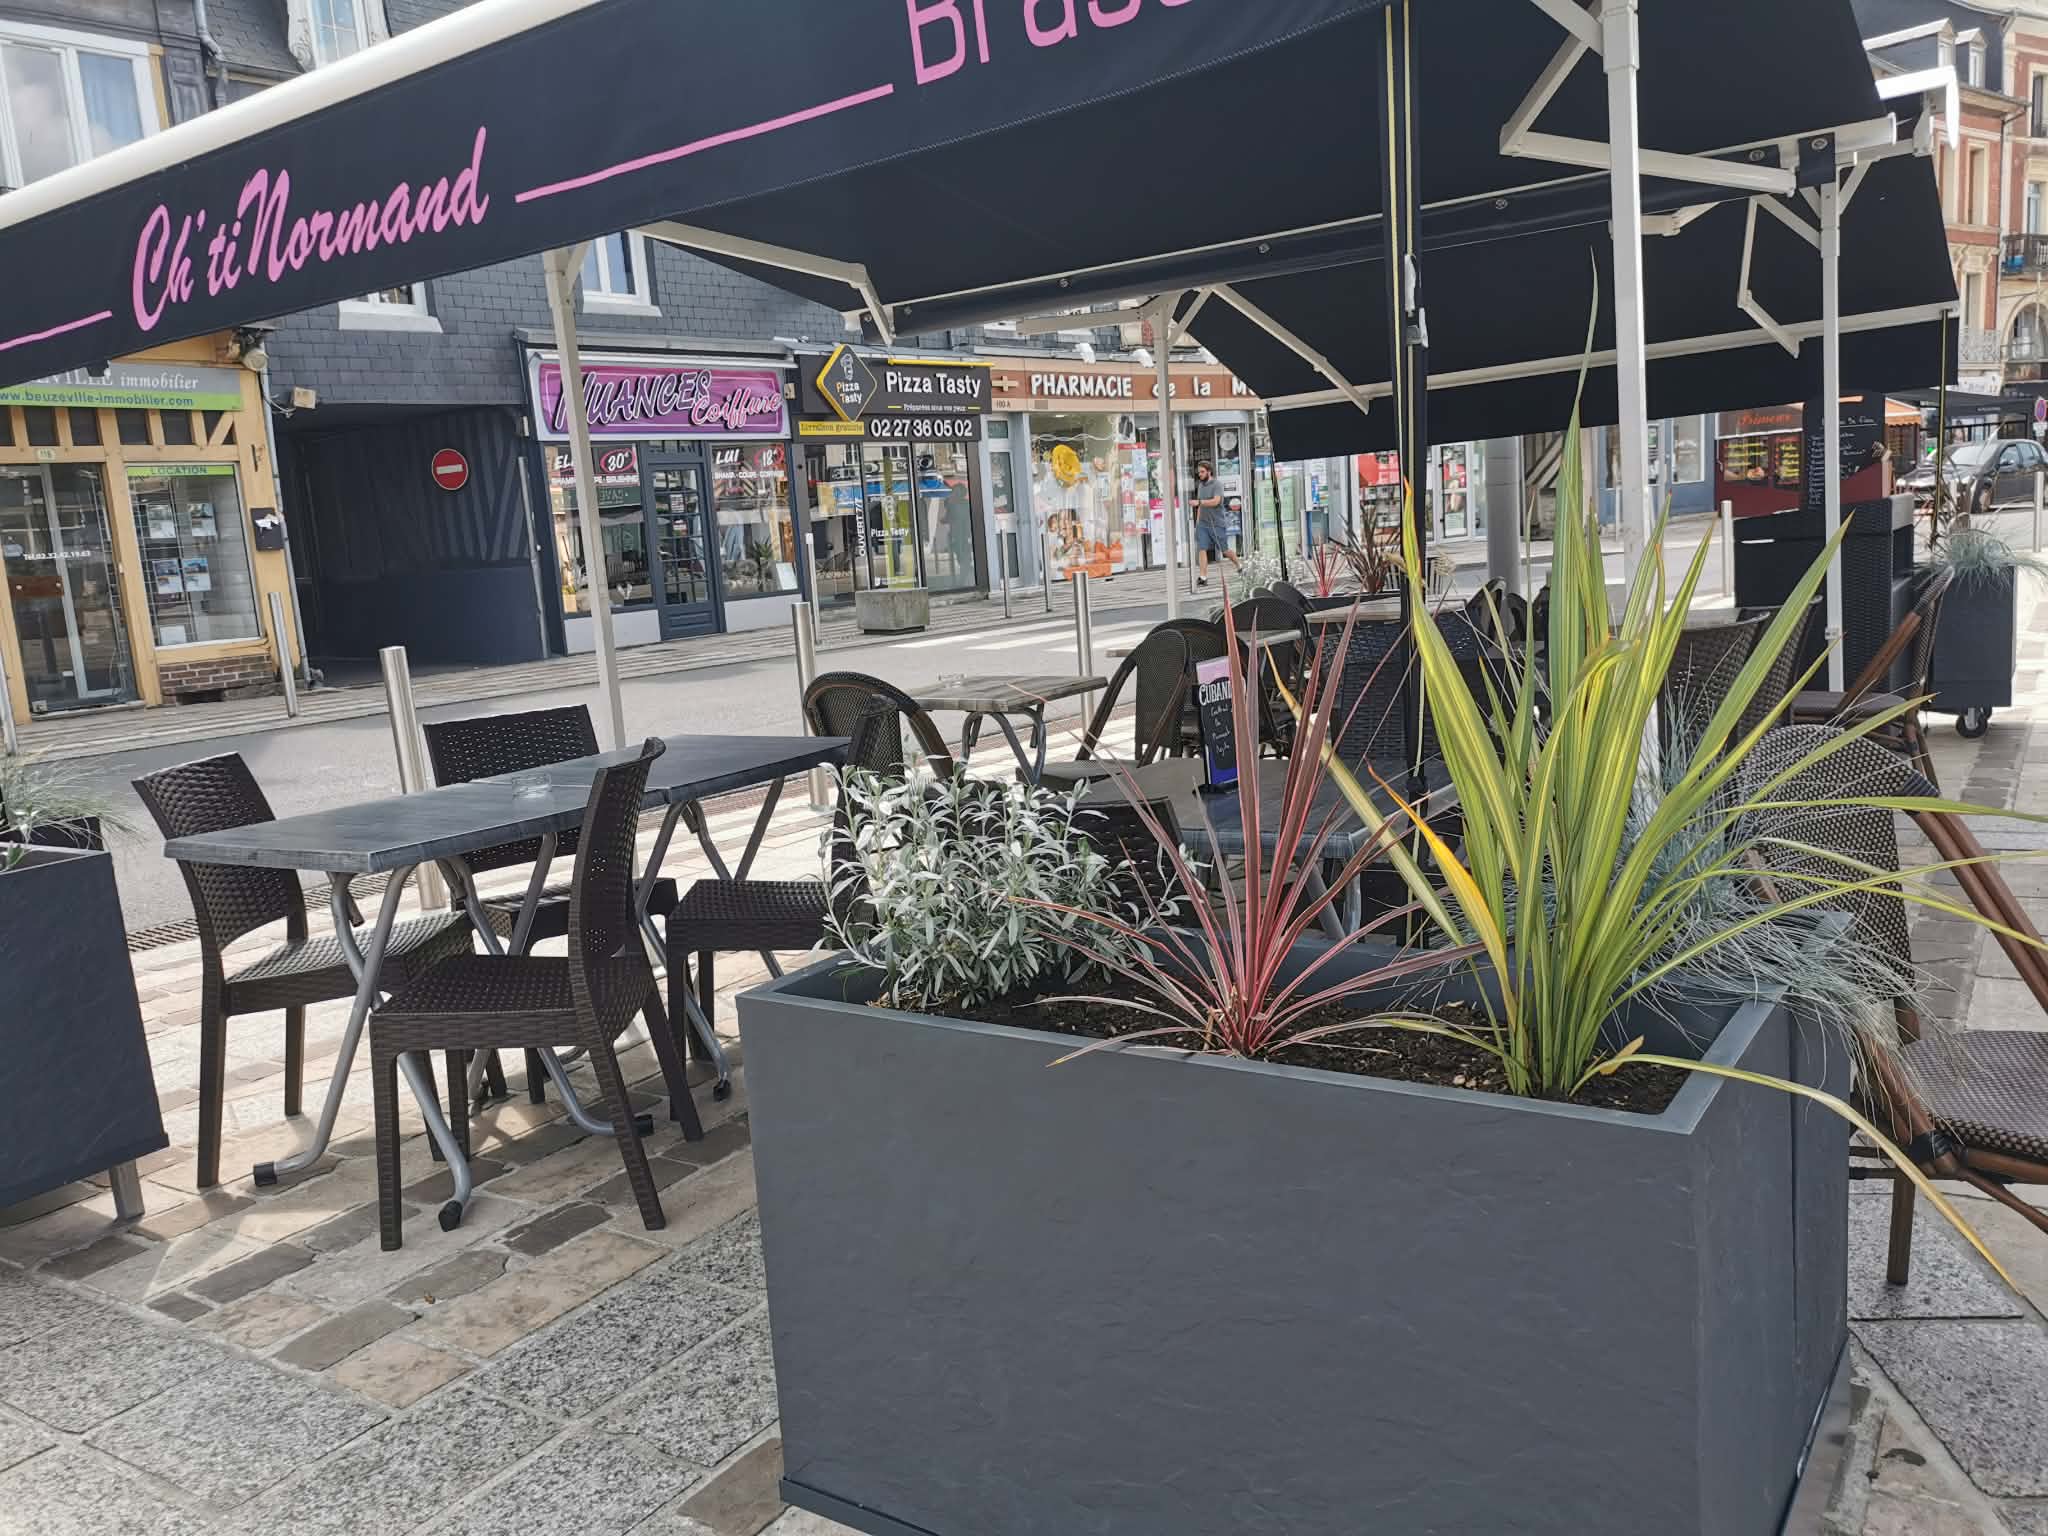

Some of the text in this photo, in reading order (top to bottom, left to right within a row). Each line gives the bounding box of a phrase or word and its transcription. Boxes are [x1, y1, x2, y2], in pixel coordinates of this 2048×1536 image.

[132, 126, 489, 332] Ch'ti Normand
[120, 372, 199, 389] immobilier
[836, 382, 860, 392] Pizza
[886, 371, 981, 398] Pizza Tasty
[1031, 373, 1132, 398] PHARMACIE
[1193, 376, 1211, 396] la
[555, 370, 784, 430] NUANCES Coiffure
[839, 392, 862, 404] Tasty
[871, 419, 972, 436] 02 27 36 05 02
[716, 449, 740, 465] LUI
[151, 465, 207, 475] LOCATION
[856, 515, 866, 556] OUVERT
[871, 528, 888, 537] Pizza
[1199, 681, 1233, 706] CUBANI
